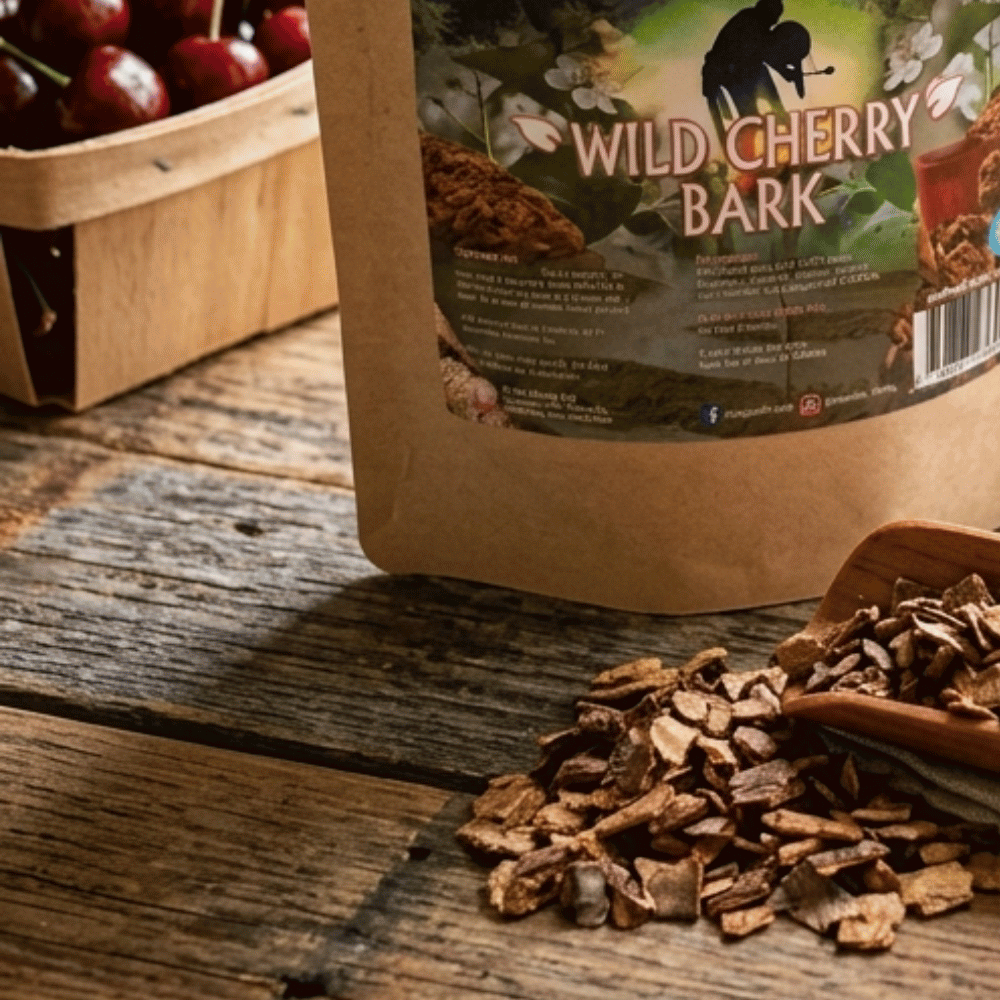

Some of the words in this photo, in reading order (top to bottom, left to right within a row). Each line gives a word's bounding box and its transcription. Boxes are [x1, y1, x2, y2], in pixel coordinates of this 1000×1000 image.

[569, 116, 710, 178] WILD
[725, 92, 920, 173] CHERRY
[681, 170, 827, 238] BARK
